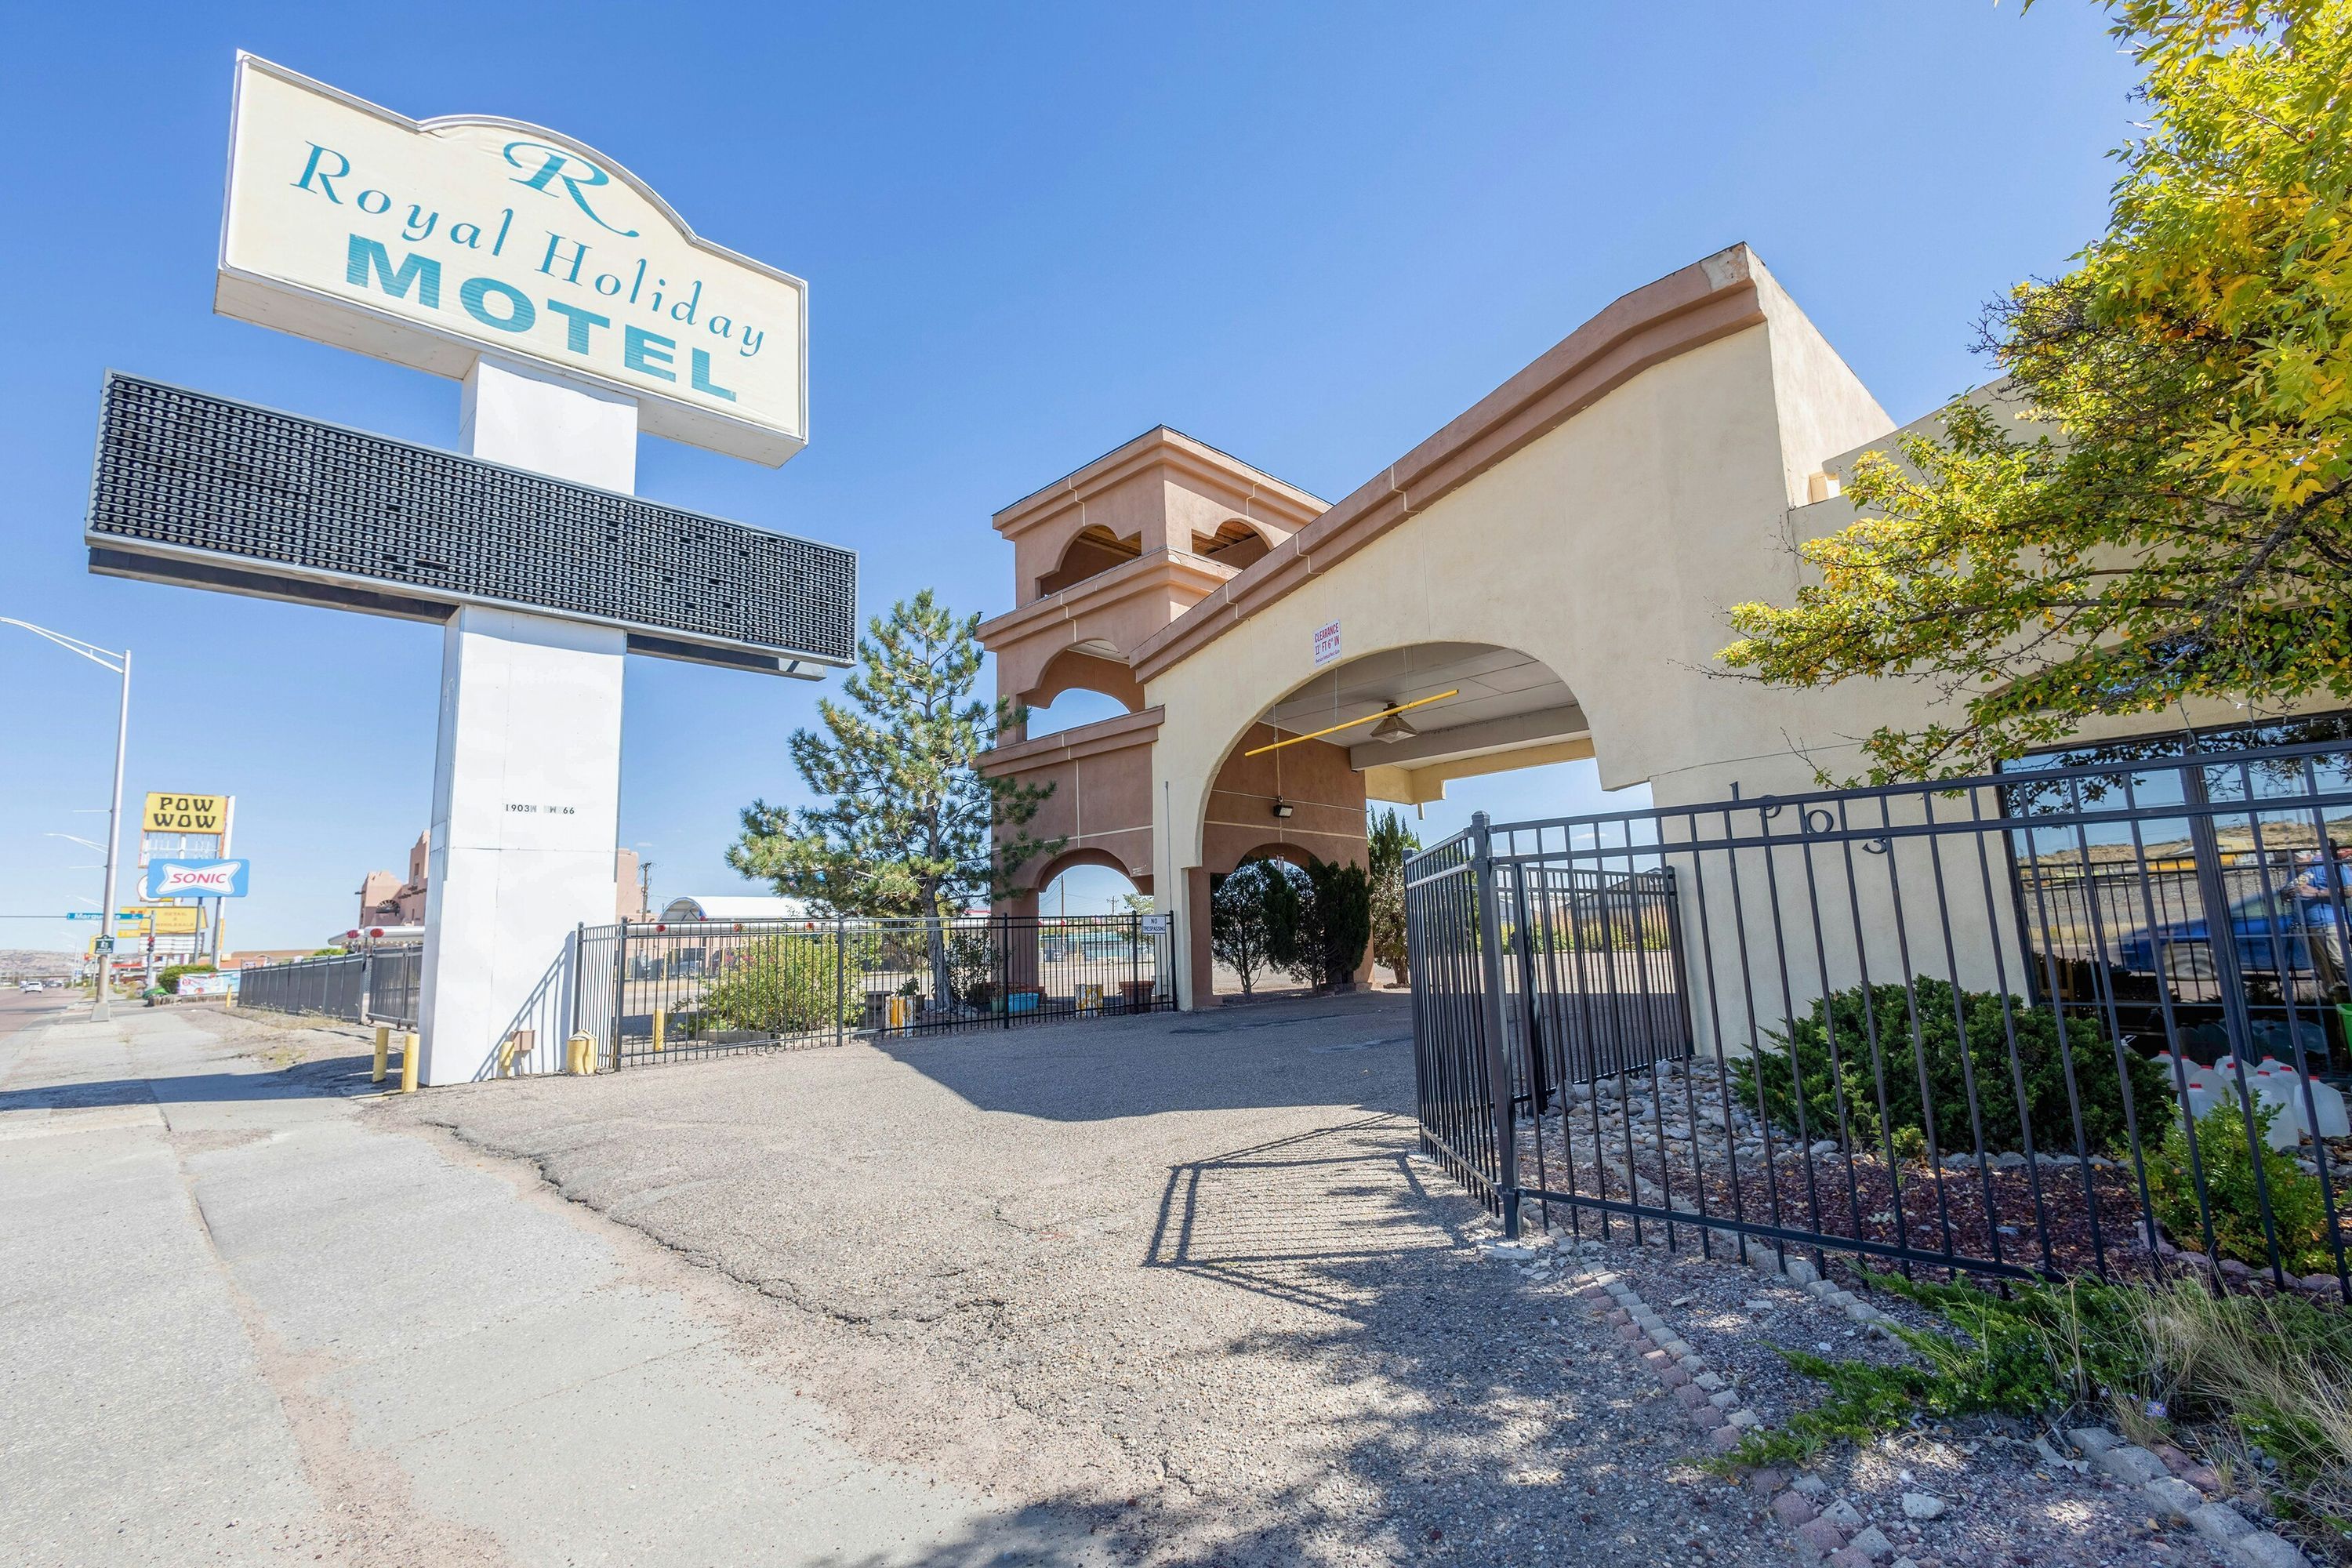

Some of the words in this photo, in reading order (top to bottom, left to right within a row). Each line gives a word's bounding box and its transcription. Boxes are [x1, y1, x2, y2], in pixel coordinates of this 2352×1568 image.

[289, 140, 514, 257] Royal
[535, 230, 764, 358] Holiday
[345, 233, 737, 403] MOTEL
[1315, 622, 1338, 642] CLEARANCE
[1322, 641, 1327, 652] FT
[159, 797, 214, 812] POW
[153, 813, 216, 828] WOW
[169, 873, 227, 884] SONIC
